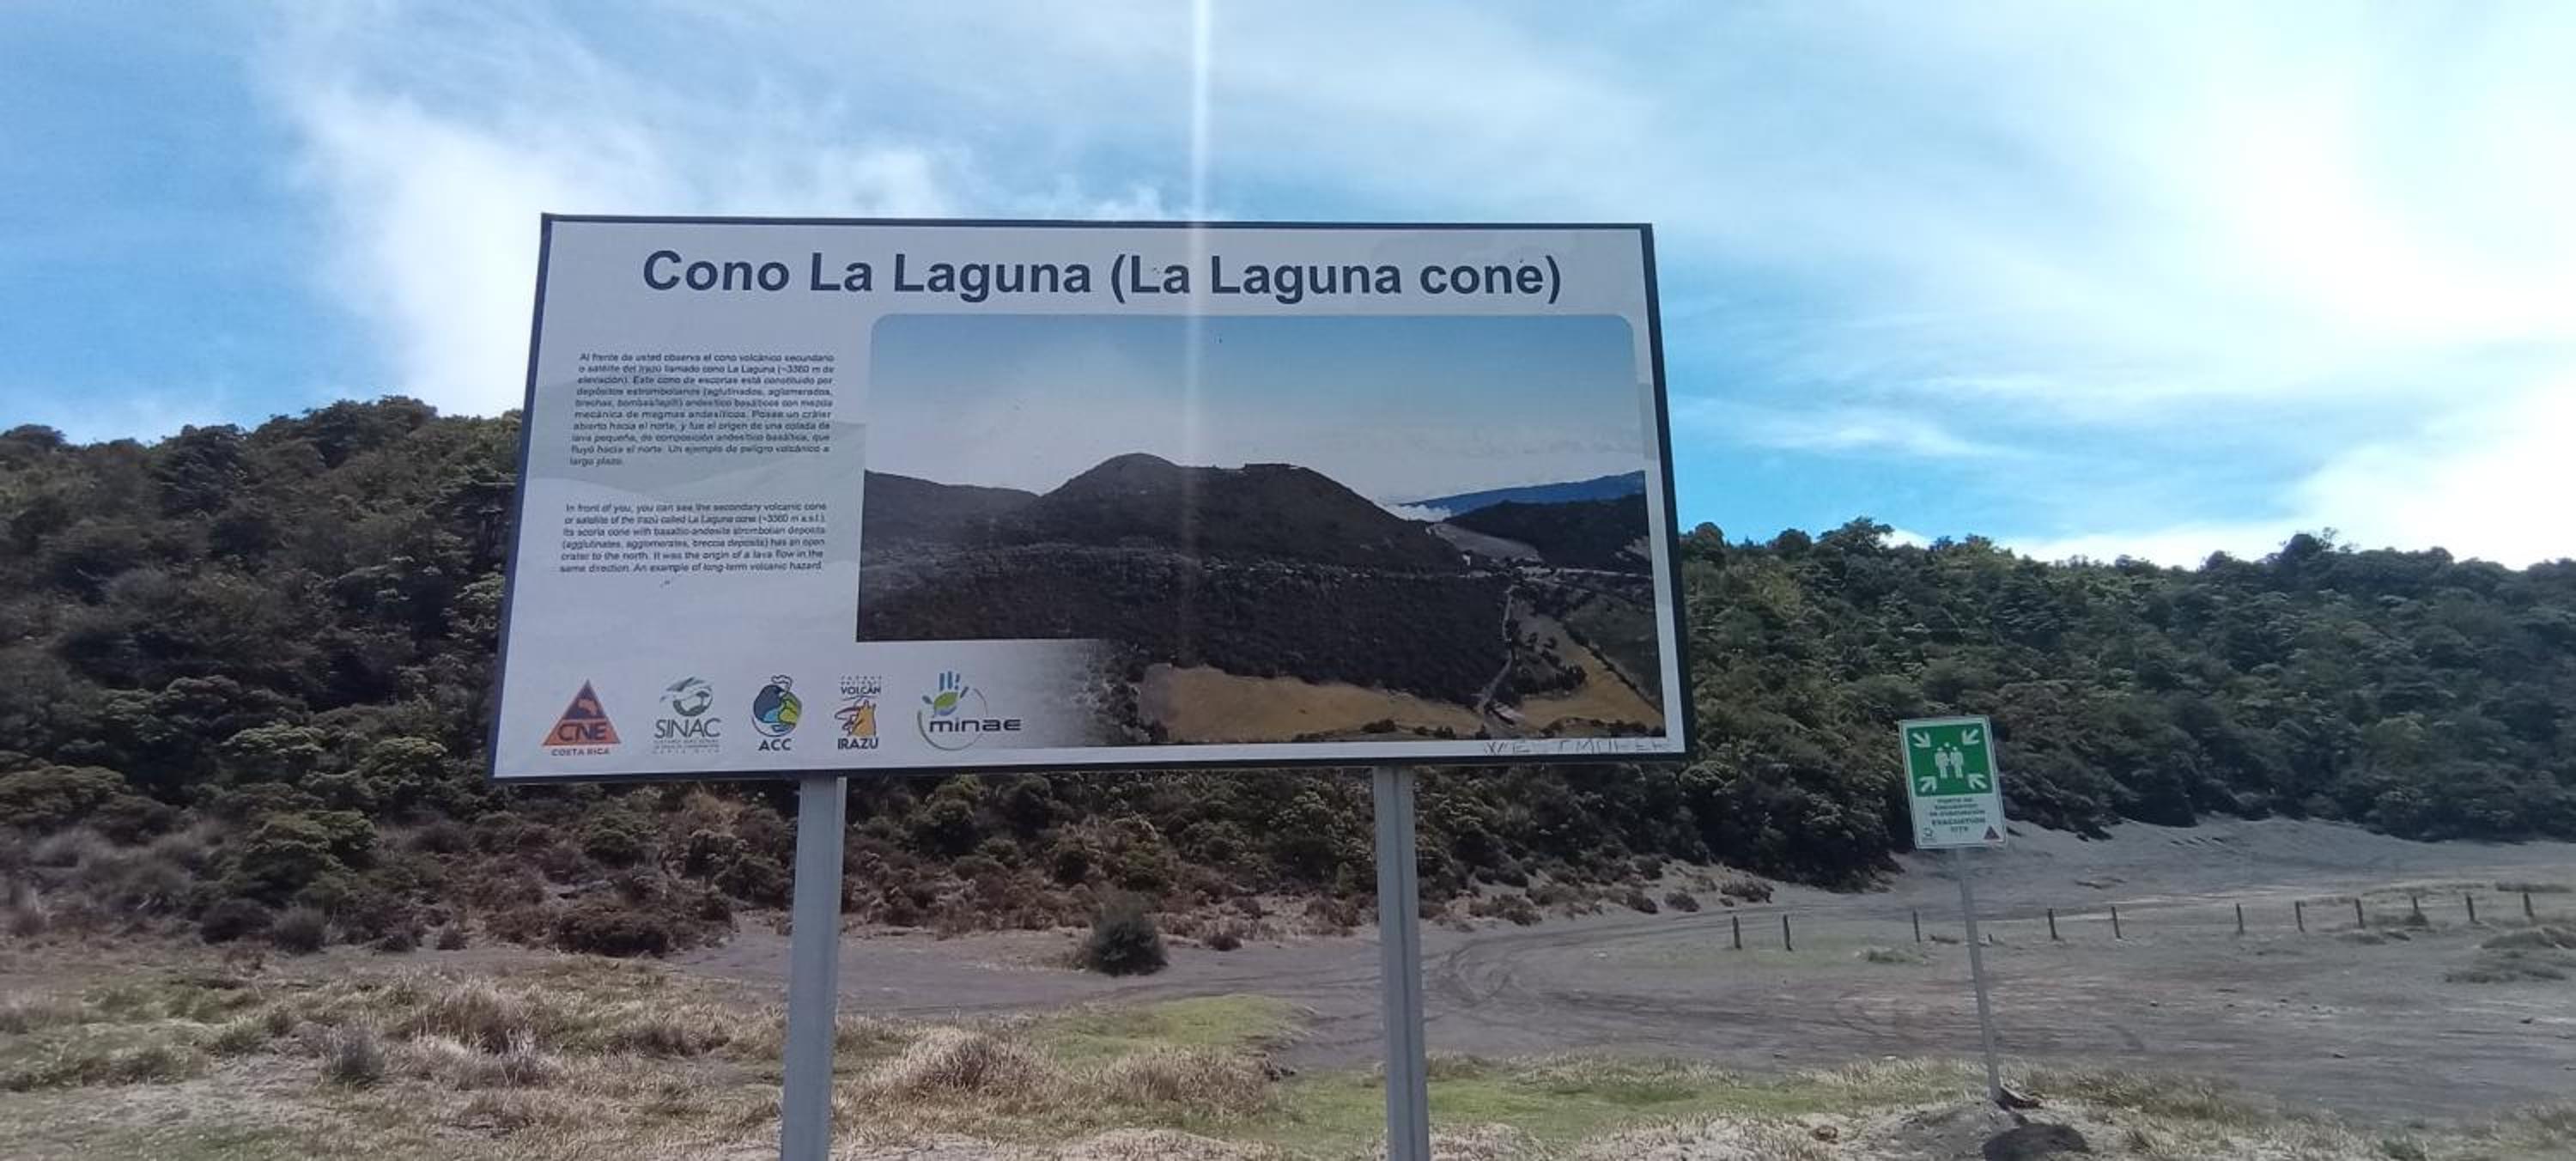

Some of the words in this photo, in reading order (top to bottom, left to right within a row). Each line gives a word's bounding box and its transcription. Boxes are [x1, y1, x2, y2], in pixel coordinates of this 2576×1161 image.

[644, 250, 789, 291] Cono
[810, 252, 872, 292] La
[894, 253, 1091, 303] Laguna
[1111, 253, 1190, 304] (La
[1212, 255, 1401, 304] Laguna
[1419, 256, 1561, 304] cone)
[557, 722, 606, 741] CNE
[654, 718, 721, 739] SINAC
[929, 719, 1022, 732] minae
[758, 739, 792, 751] ACC
